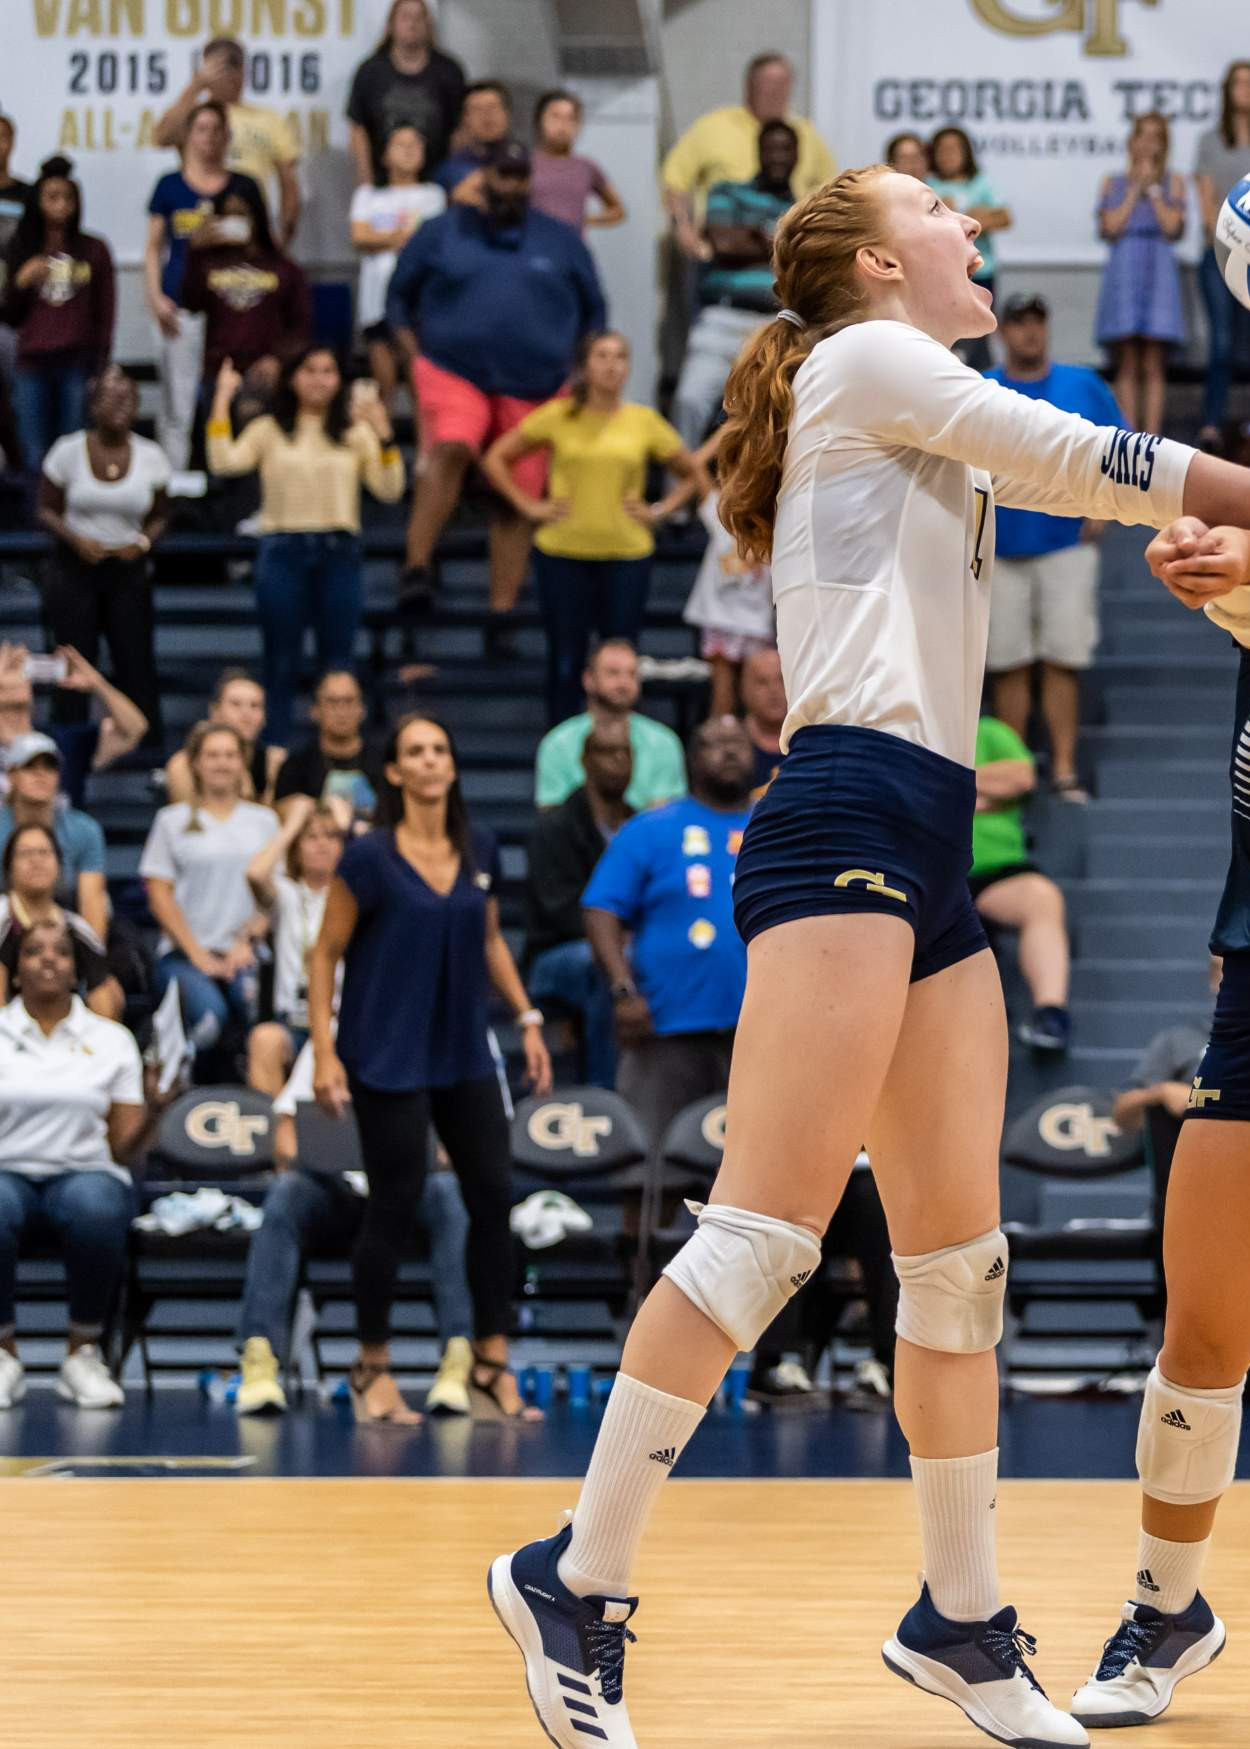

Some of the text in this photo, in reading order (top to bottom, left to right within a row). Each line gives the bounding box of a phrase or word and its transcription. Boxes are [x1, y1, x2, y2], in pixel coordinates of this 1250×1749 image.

[69, 51, 168, 94] 2015
[873, 79, 1226, 122] GEORGIA TEC
[184, 1101, 269, 1155] GT
[527, 1102, 613, 1157] GT
[1160, 1416, 1192, 1431] adidas
